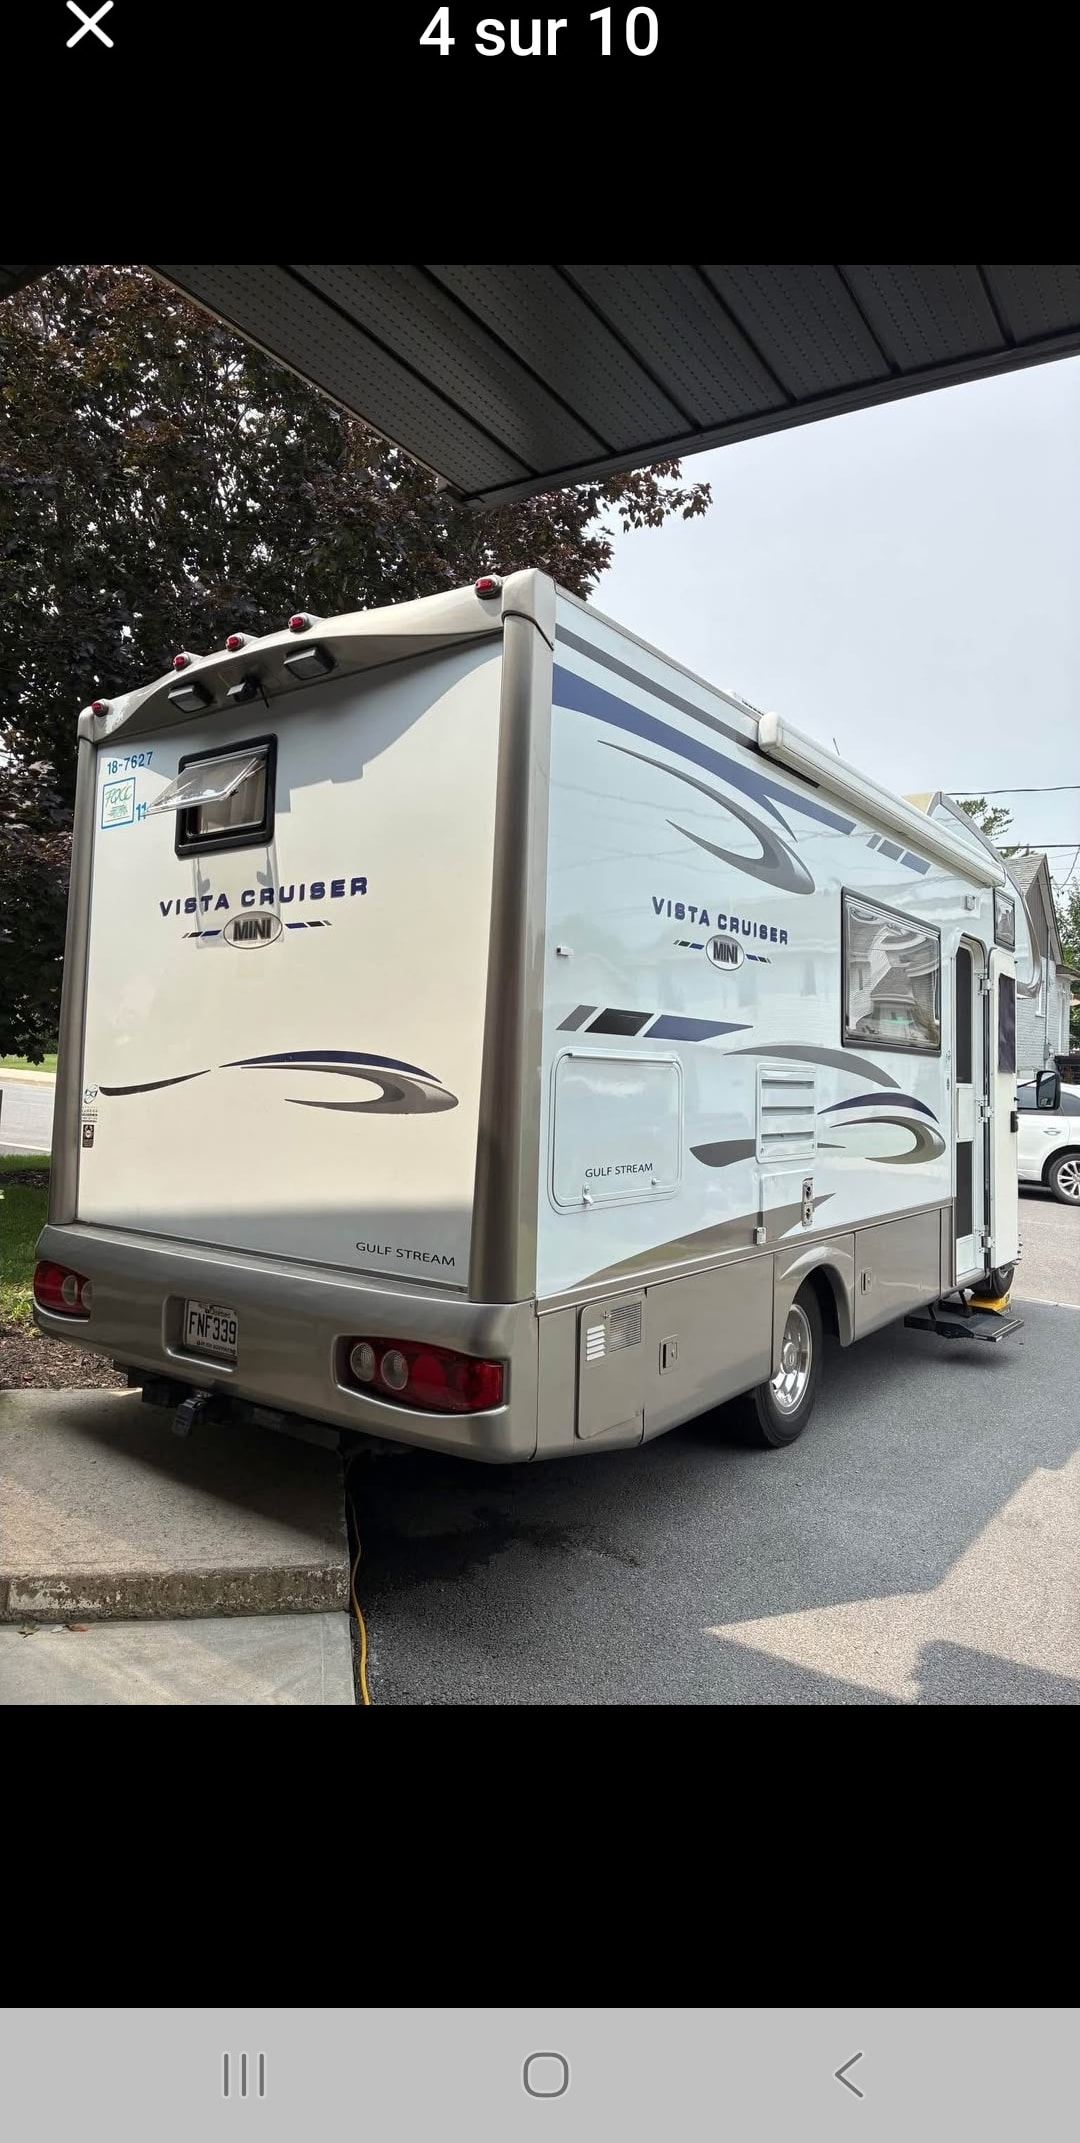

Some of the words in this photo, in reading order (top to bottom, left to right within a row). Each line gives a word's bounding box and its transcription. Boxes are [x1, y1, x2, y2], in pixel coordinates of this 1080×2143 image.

[107, 751, 154, 775] 18-7627
[159, 893, 230, 917] VISTA
[240, 876, 368, 908] CRUISER
[233, 917, 272, 942] MINI
[652, 896, 710, 927] VISTA
[717, 913, 788, 945] CRUISER
[713, 940, 738, 964] MINI
[585, 1166, 612, 1178] GULF
[615, 1162, 653, 1175] STREAM
[355, 1242, 392, 1256] GULF
[396, 1248, 455, 1267] STREAM
[189, 1311, 237, 1344] FNF339
